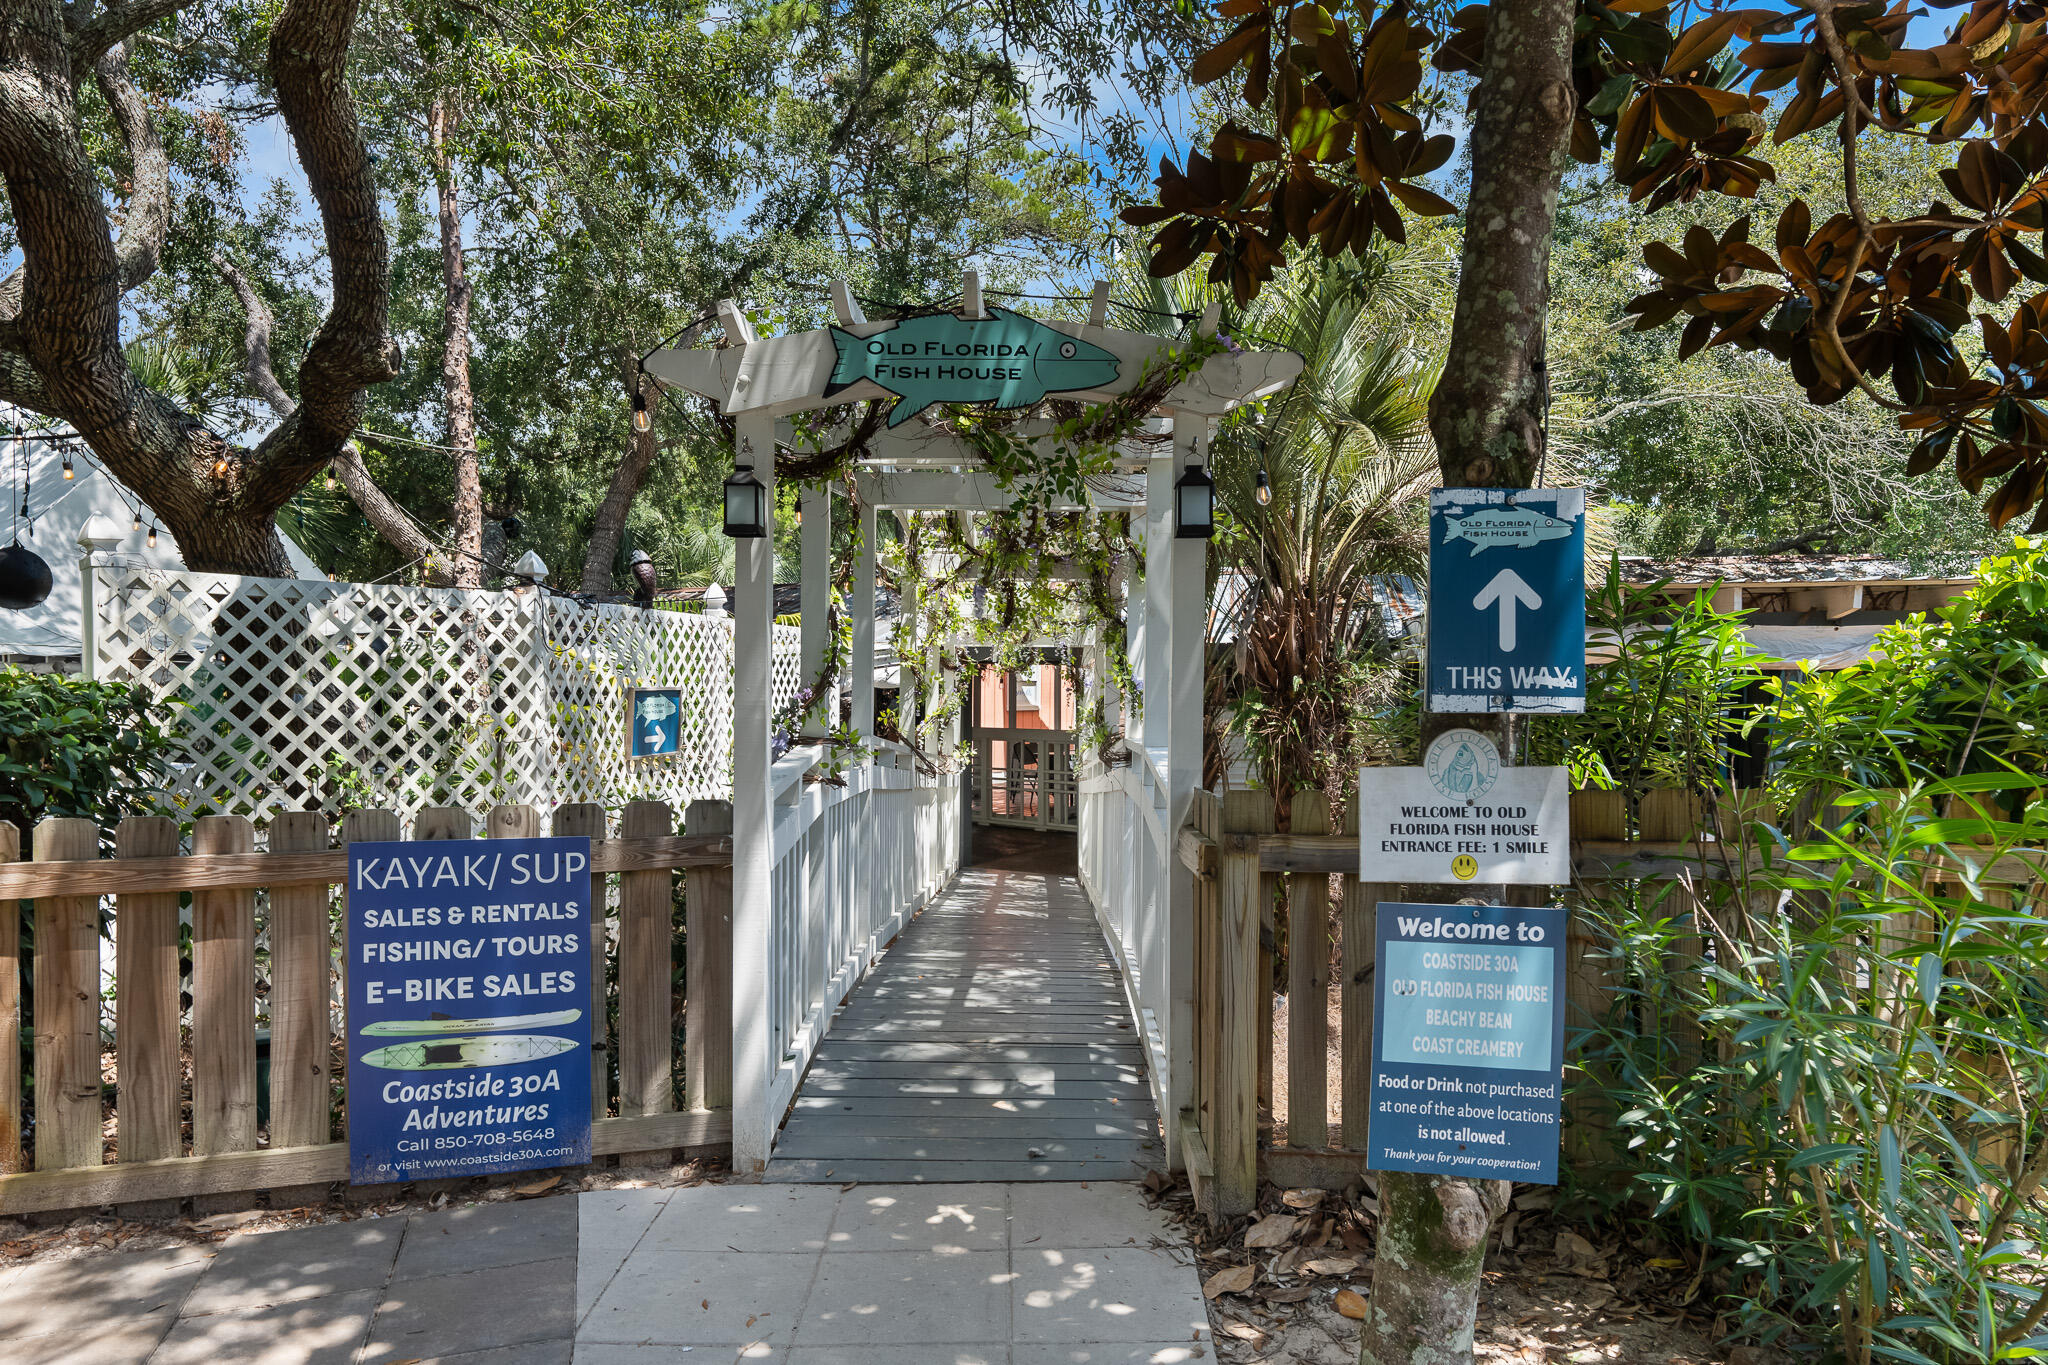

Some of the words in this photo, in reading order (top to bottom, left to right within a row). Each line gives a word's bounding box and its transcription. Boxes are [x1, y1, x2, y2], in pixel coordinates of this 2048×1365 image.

[867, 341, 916, 355] OLD
[925, 342, 1028, 356] FLORIDA
[875, 364, 929, 379] FISH
[938, 365, 1021, 380] HOUSE
[1446, 666, 1502, 689] THIS
[1510, 666, 1572, 689] WAY
[1401, 806, 1469, 819] WELCOME
[1474, 806, 1492, 819] TO
[1498, 806, 1526, 819] OLD
[1390, 823, 1449, 835] FLORIDA
[1454, 824, 1486, 836] FISH
[1491, 824, 1539, 836] HOUSE
[1382, 840, 1452, 853] ENTRANCE
[1458, 841, 1486, 853] FEE:
[1493, 841, 1499, 853] 1
[1506, 842, 1549, 854] SMILE
[356, 853, 502, 891] KAYAK/
[510, 852, 586, 885] SUP
[363, 907, 442, 928] SALES
[447, 906, 465, 925] &
[471, 901, 579, 924] RENTALS
[1397, 917, 1510, 939] Welcome
[1516, 922, 1545, 942] to
[363, 938, 486, 964] FISHING/
[491, 934, 579, 957] TOURS
[1423, 952, 1491, 971] COASTSIDE
[1494, 955, 1518, 972] 30A
[366, 976, 474, 1004] E-BIKE
[482, 970, 576, 997] SALES
[1393, 979, 1417, 996] OLD
[1421, 981, 1473, 999] FLORIDA
[1476, 984, 1503, 1000] FISH
[1507, 985, 1548, 1002] HOUSE
[1426, 1009, 1475, 1027] BEACHY
[1479, 1011, 1512, 1029] BEAN
[1413, 1036, 1453, 1054] COAST
[1456, 1039, 1524, 1057] CREAMERY
[382, 1072, 504, 1104] Coastside
[508, 1069, 560, 1098] 30A
[1378, 1074, 1409, 1089] Food
[1411, 1079, 1424, 1090] or
[1427, 1077, 1463, 1092] Drink
[1466, 1082, 1487, 1094] not
[1489, 1082, 1555, 1099] purchased
[402, 1103, 549, 1132] Adventures
[1379, 1101, 1391, 1112] at
[1394, 1103, 1417, 1114] one
[1420, 1101, 1433, 1115] of
[1434, 1101, 1455, 1116] the
[1457, 1104, 1494, 1119] above
[1497, 1105, 1553, 1124] locations
[397, 1138, 429, 1152] Call
[434, 1127, 555, 1150] 850-708-5648
[1418, 1125, 1428, 1138] is
[1431, 1128, 1452, 1140] not
[378, 1162, 391, 1172] or
[394, 1159, 421, 1171] visit
[424, 1146, 573, 1168] www.coastside30A.com
[1384, 1148, 1415, 1160] Thank
[1415, 1152, 1435, 1162] you
[1437, 1152, 1451, 1163] for
[1451, 1154, 1476, 1165] your
[1477, 1156, 1541, 1170] cooperation!
